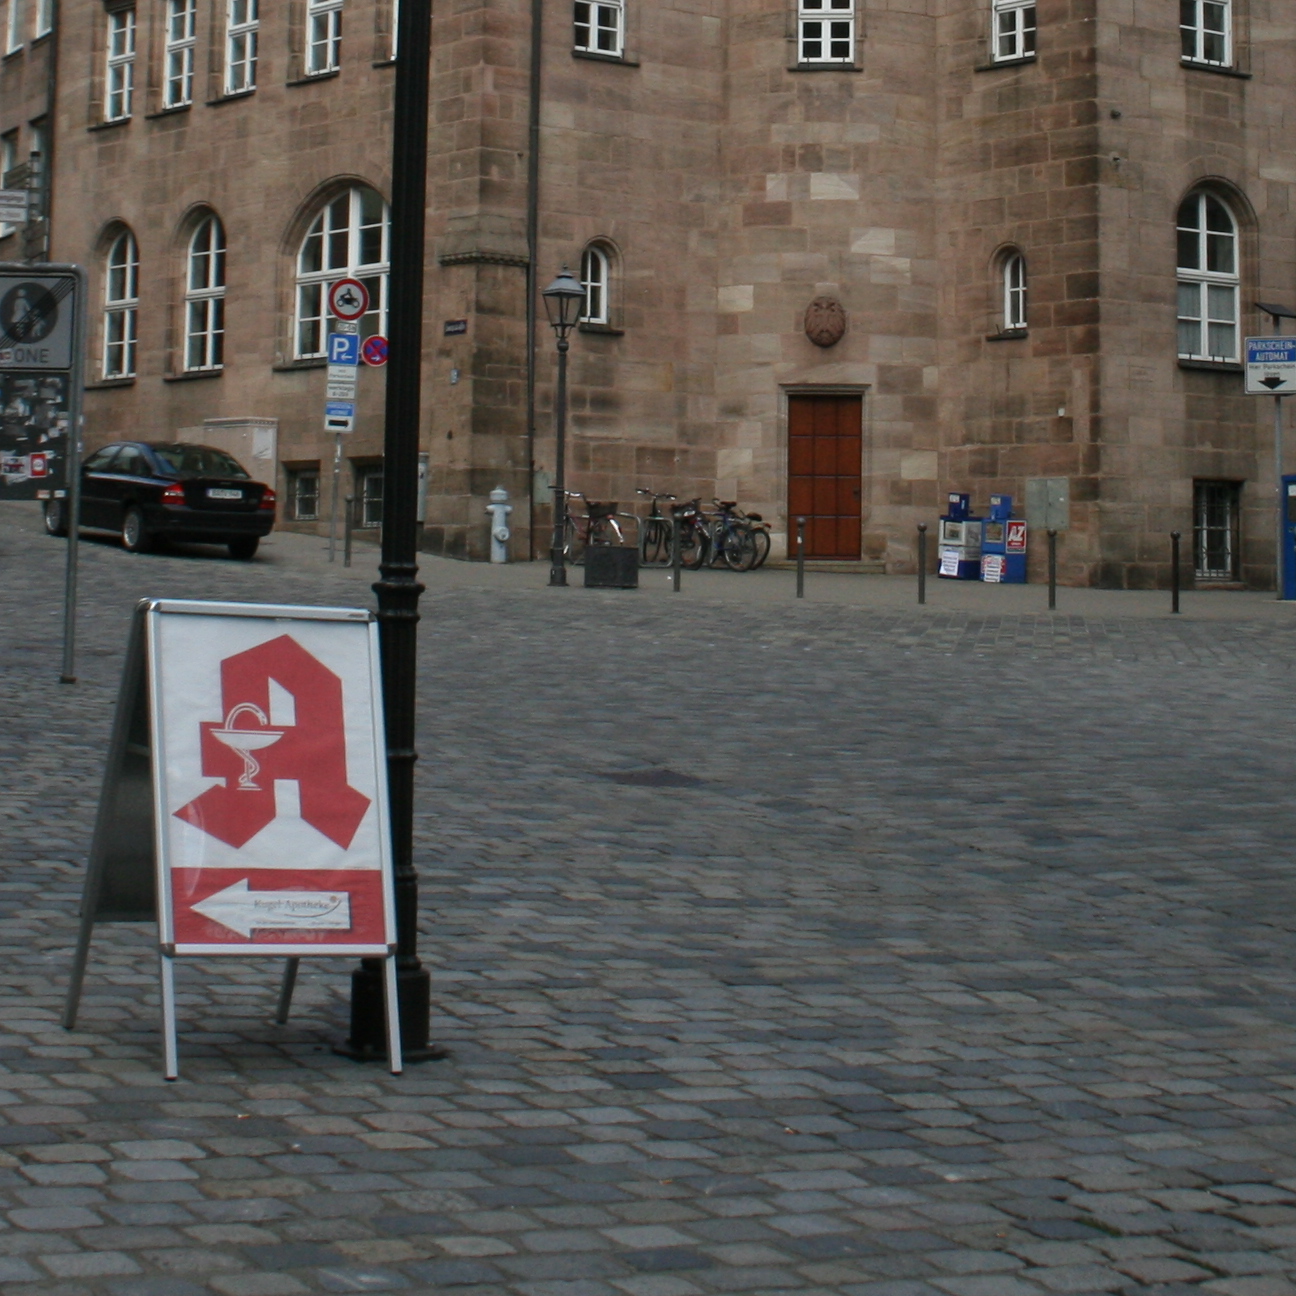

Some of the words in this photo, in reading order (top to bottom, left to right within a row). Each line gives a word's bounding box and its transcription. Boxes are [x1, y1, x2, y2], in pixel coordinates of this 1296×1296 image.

[332, 337, 350, 361] P
[1248, 341, 1296, 351] PARKSCHEIN-
[1255, 351, 1289, 361] AUTOMAT
[1008, 525, 1025, 542] AZ
[286, 899, 330, 911] Apotheke
